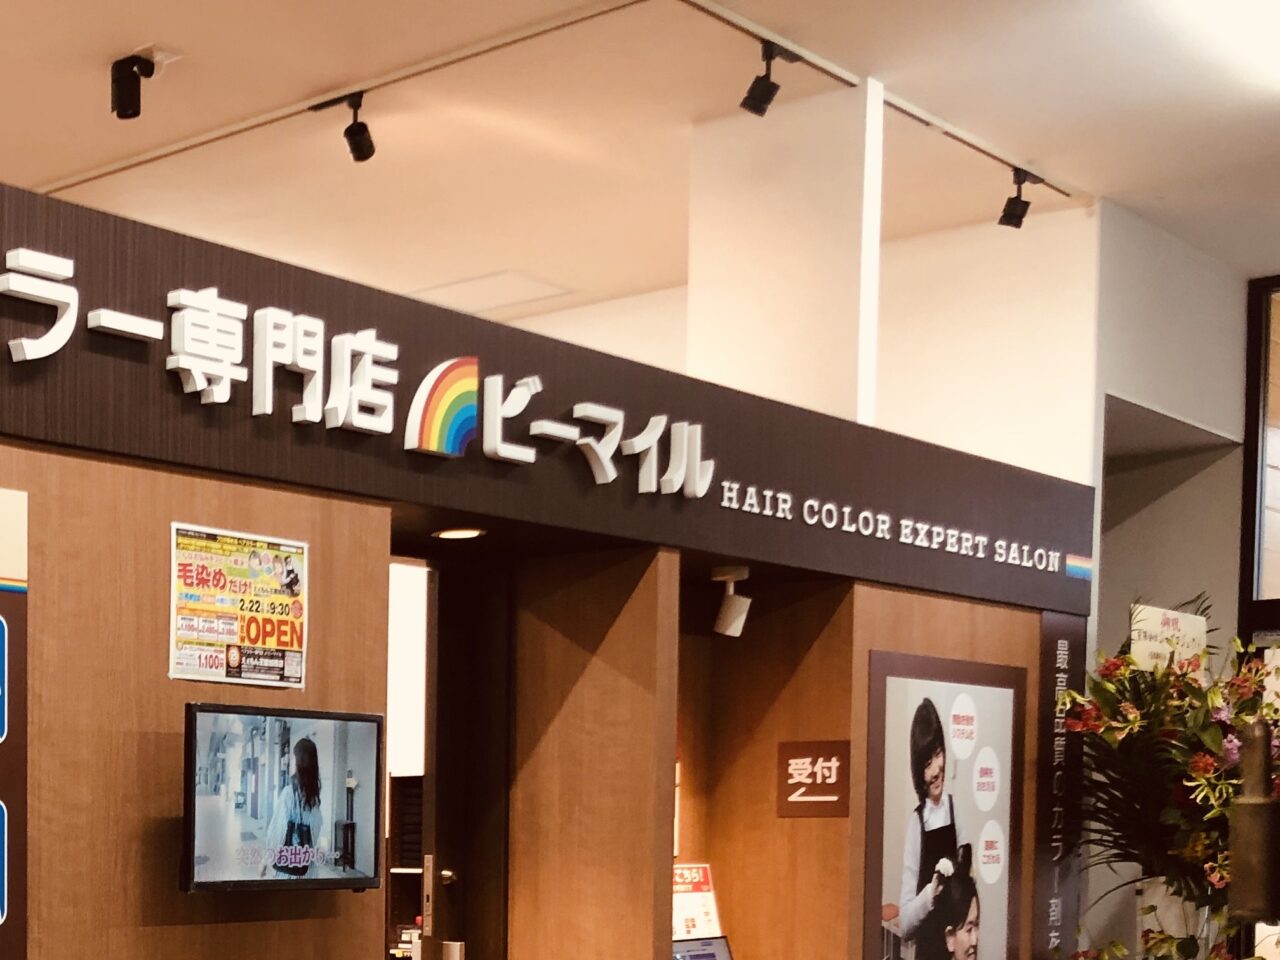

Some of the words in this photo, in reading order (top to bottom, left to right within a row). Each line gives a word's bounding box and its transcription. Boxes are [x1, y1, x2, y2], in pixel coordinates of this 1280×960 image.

[483, 374, 715, 499] ビーマイル
[721, 481, 793, 521] HAIR
[802, 498, 891, 540] COLOR
[900, 518, 987, 560] EXPERT
[993, 539, 1061, 573] SALON
[246, 615, 303, 649] OPEN
[787, 757, 840, 784] 受付
